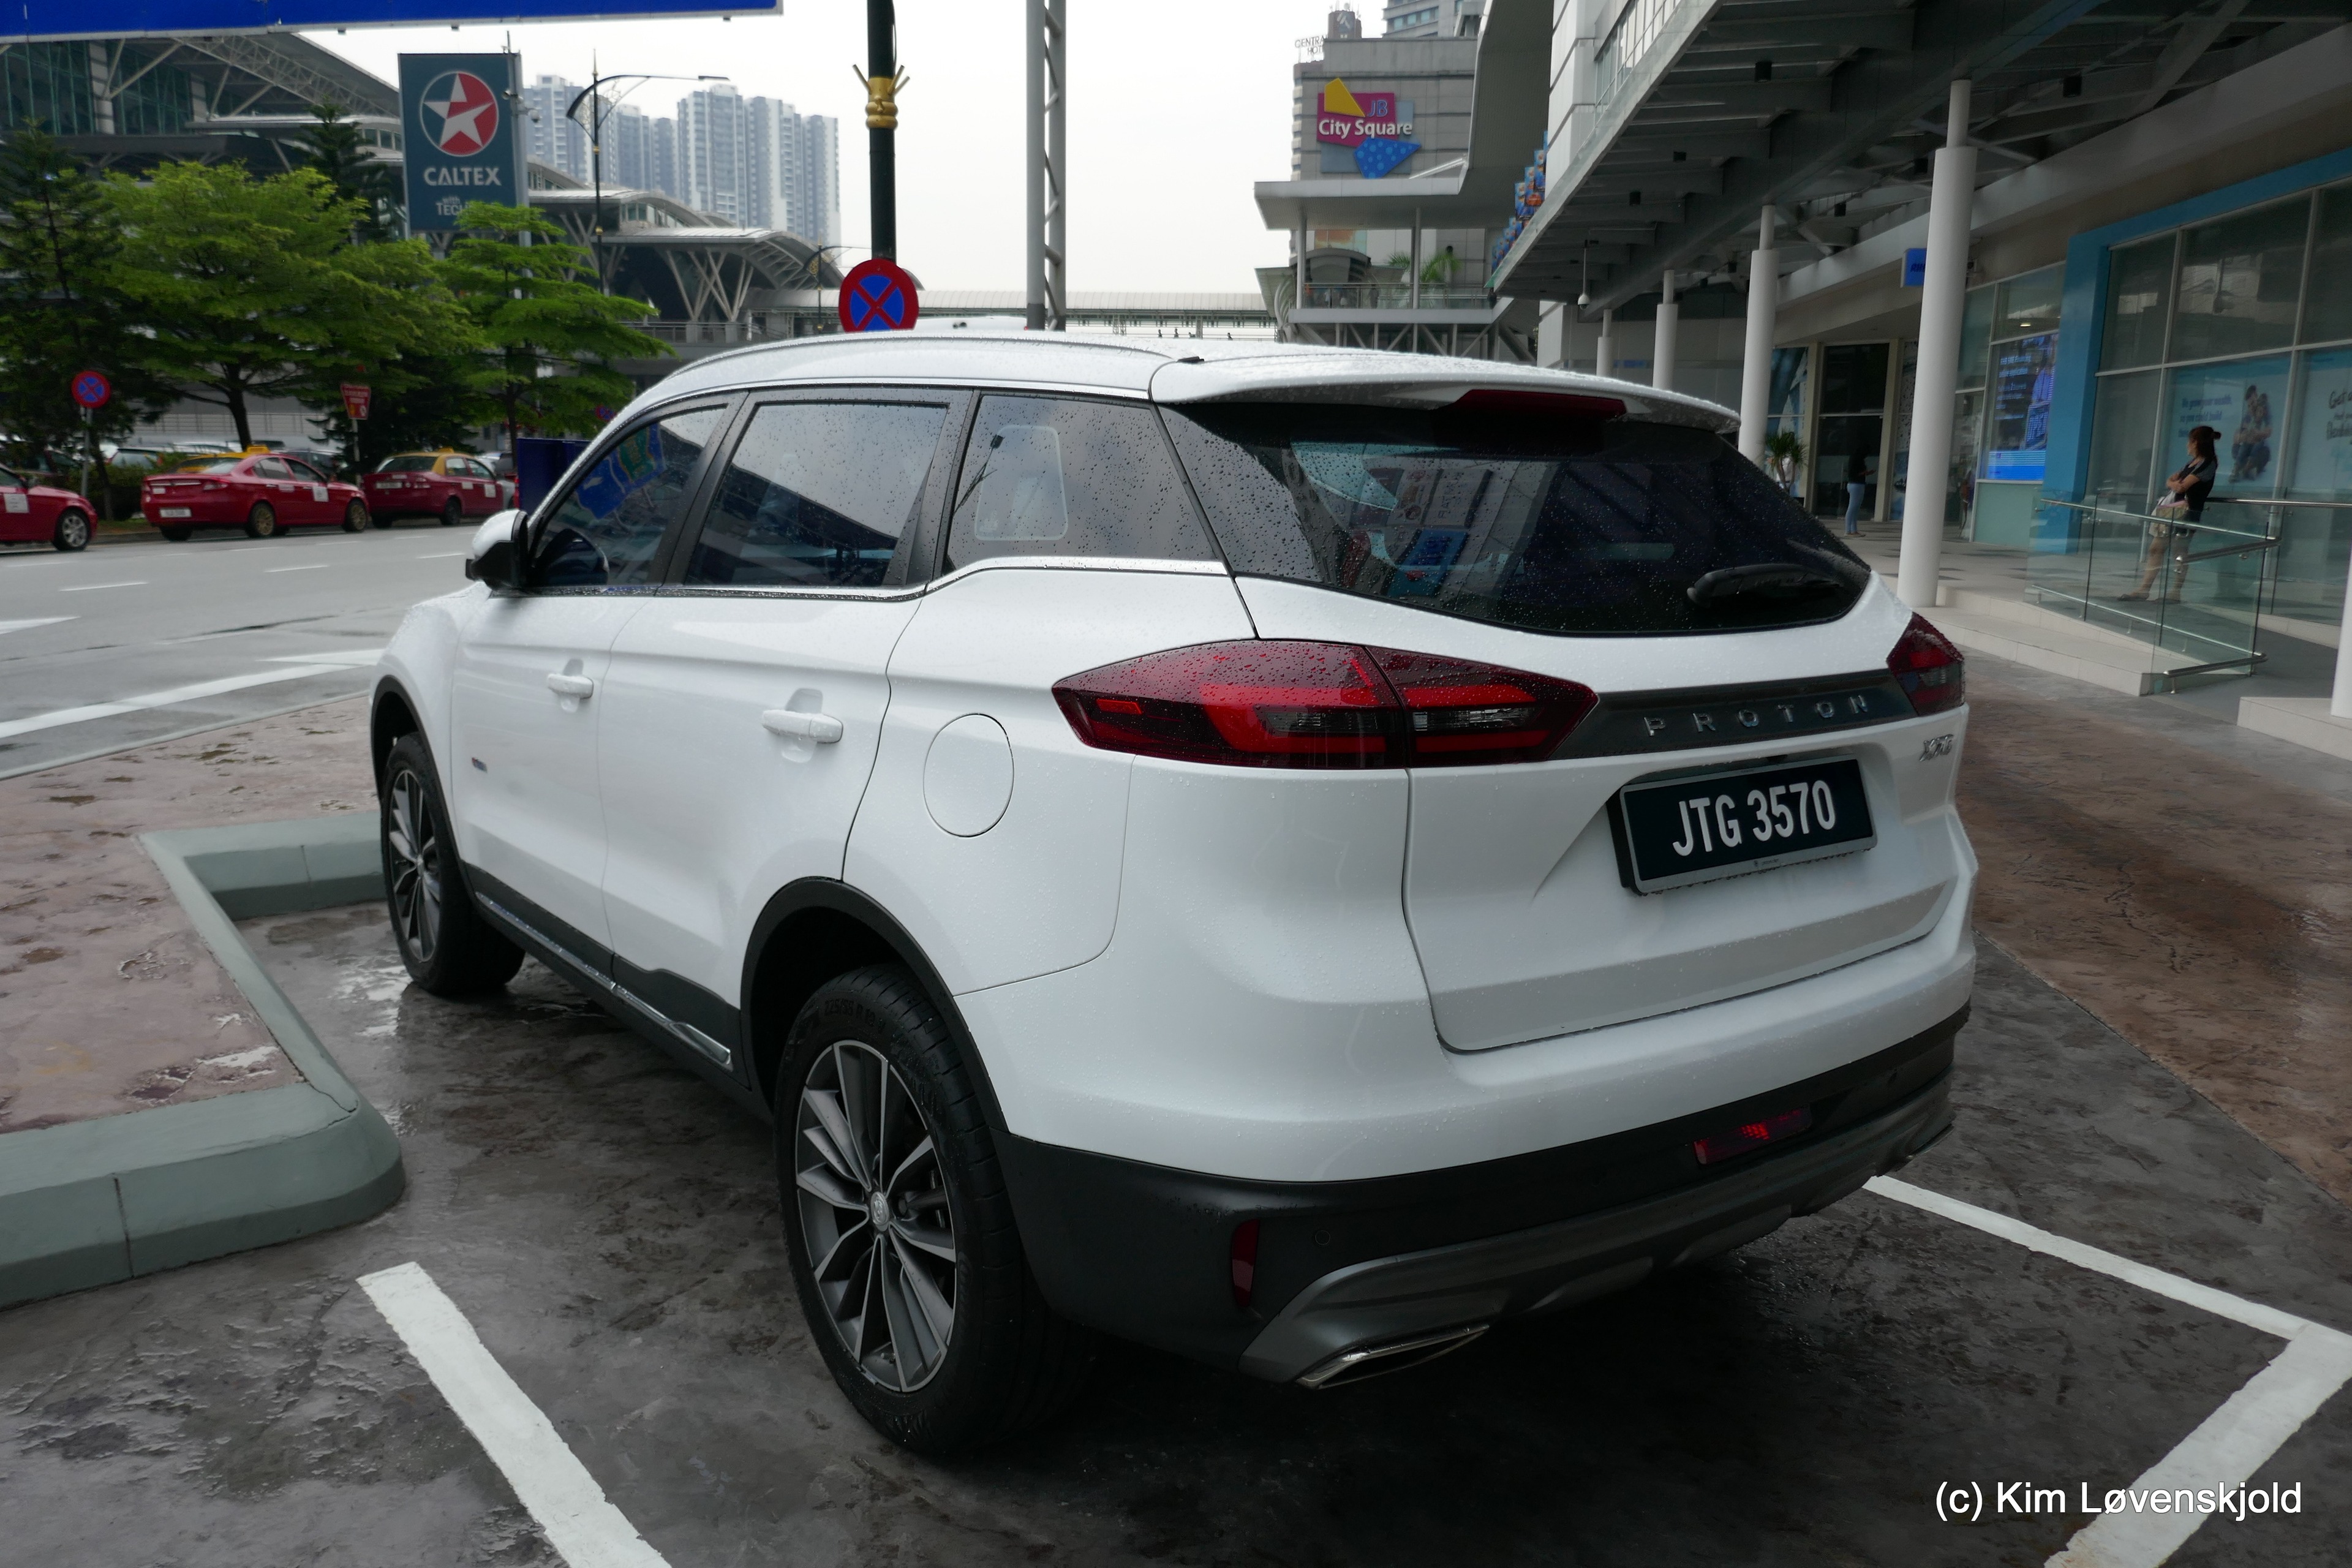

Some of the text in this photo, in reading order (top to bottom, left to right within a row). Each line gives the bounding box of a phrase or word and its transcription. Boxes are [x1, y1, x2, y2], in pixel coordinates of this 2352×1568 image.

[1294, 36, 1327, 48] CENTRA
[1307, 45, 1324, 55] HOT
[1368, 100, 1388, 117] JB
[1319, 119, 1412, 139] City Square
[424, 167, 502, 186] CALTEX
[1643, 695, 1868, 736] PROTON
[1672, 780, 1836, 856] JTG 3570
